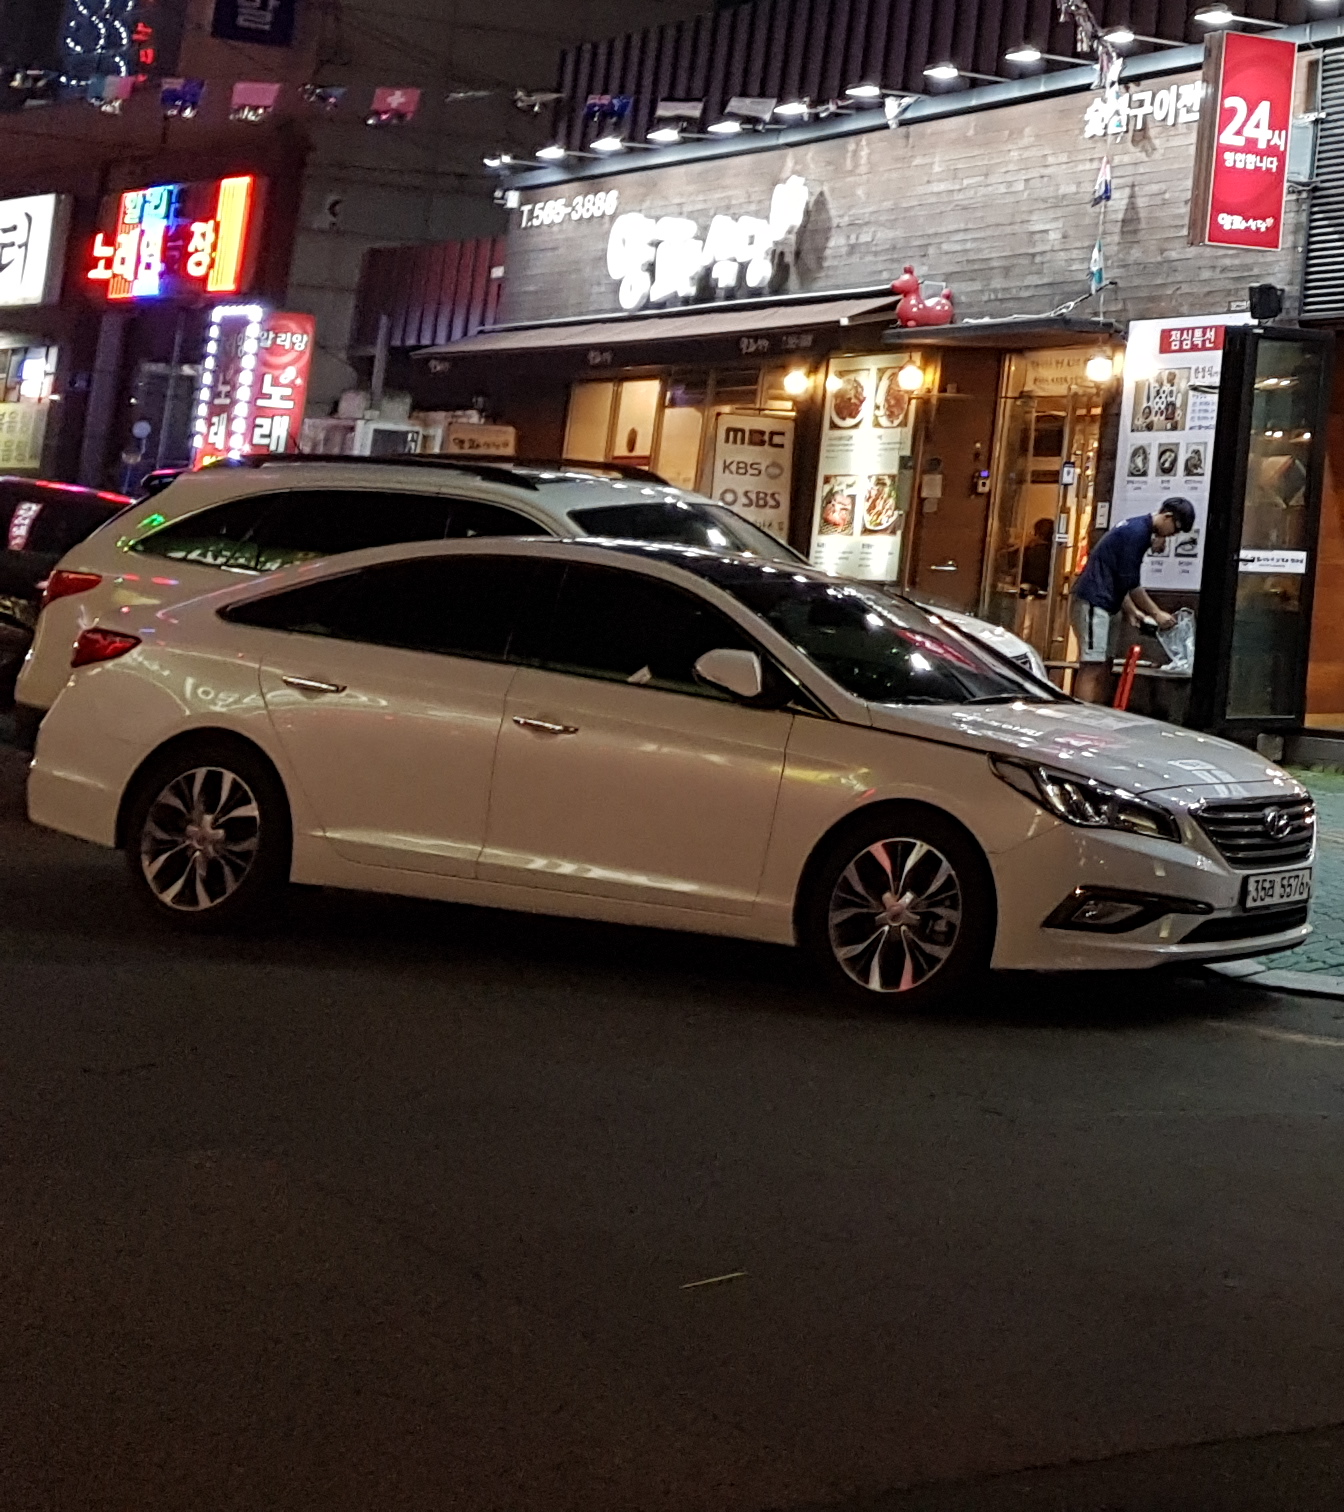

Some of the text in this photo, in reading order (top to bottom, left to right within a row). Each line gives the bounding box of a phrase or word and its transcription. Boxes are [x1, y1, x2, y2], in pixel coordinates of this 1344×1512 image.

[1169, 328, 1216, 350] 점심특선
[251, 373, 295, 454] 노래
[722, 458, 762, 477] KBS
[741, 490, 781, 510] SBS
